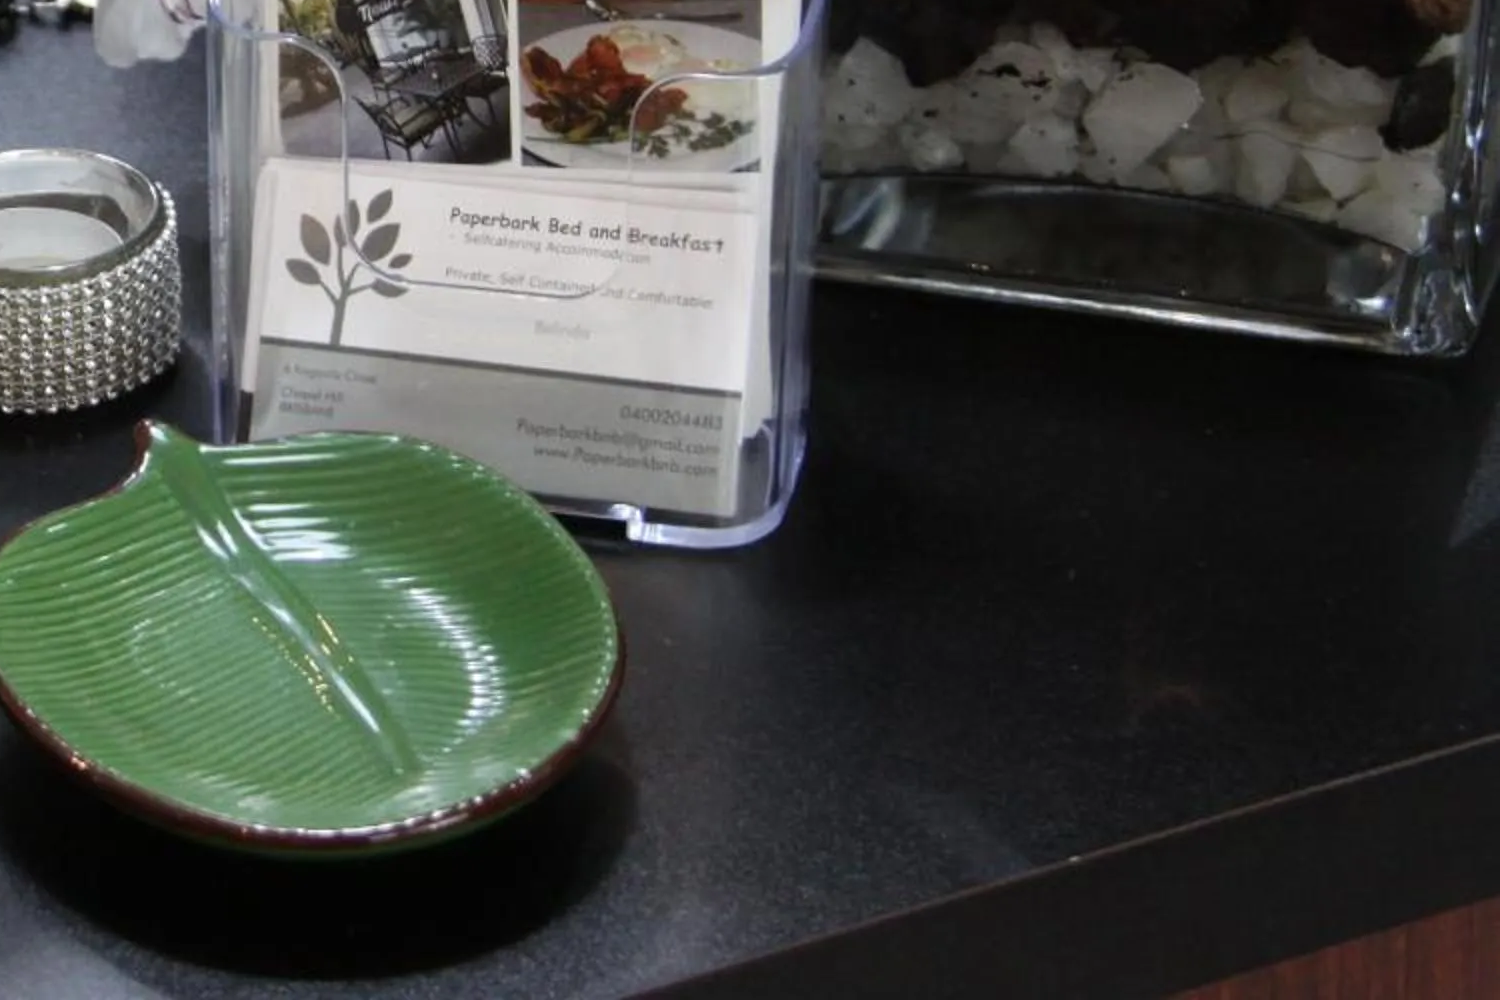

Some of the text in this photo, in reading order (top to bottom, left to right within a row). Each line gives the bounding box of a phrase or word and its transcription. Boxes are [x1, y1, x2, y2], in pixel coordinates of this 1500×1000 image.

[449, 206, 725, 254] Paperbark Bed and Breakfast
